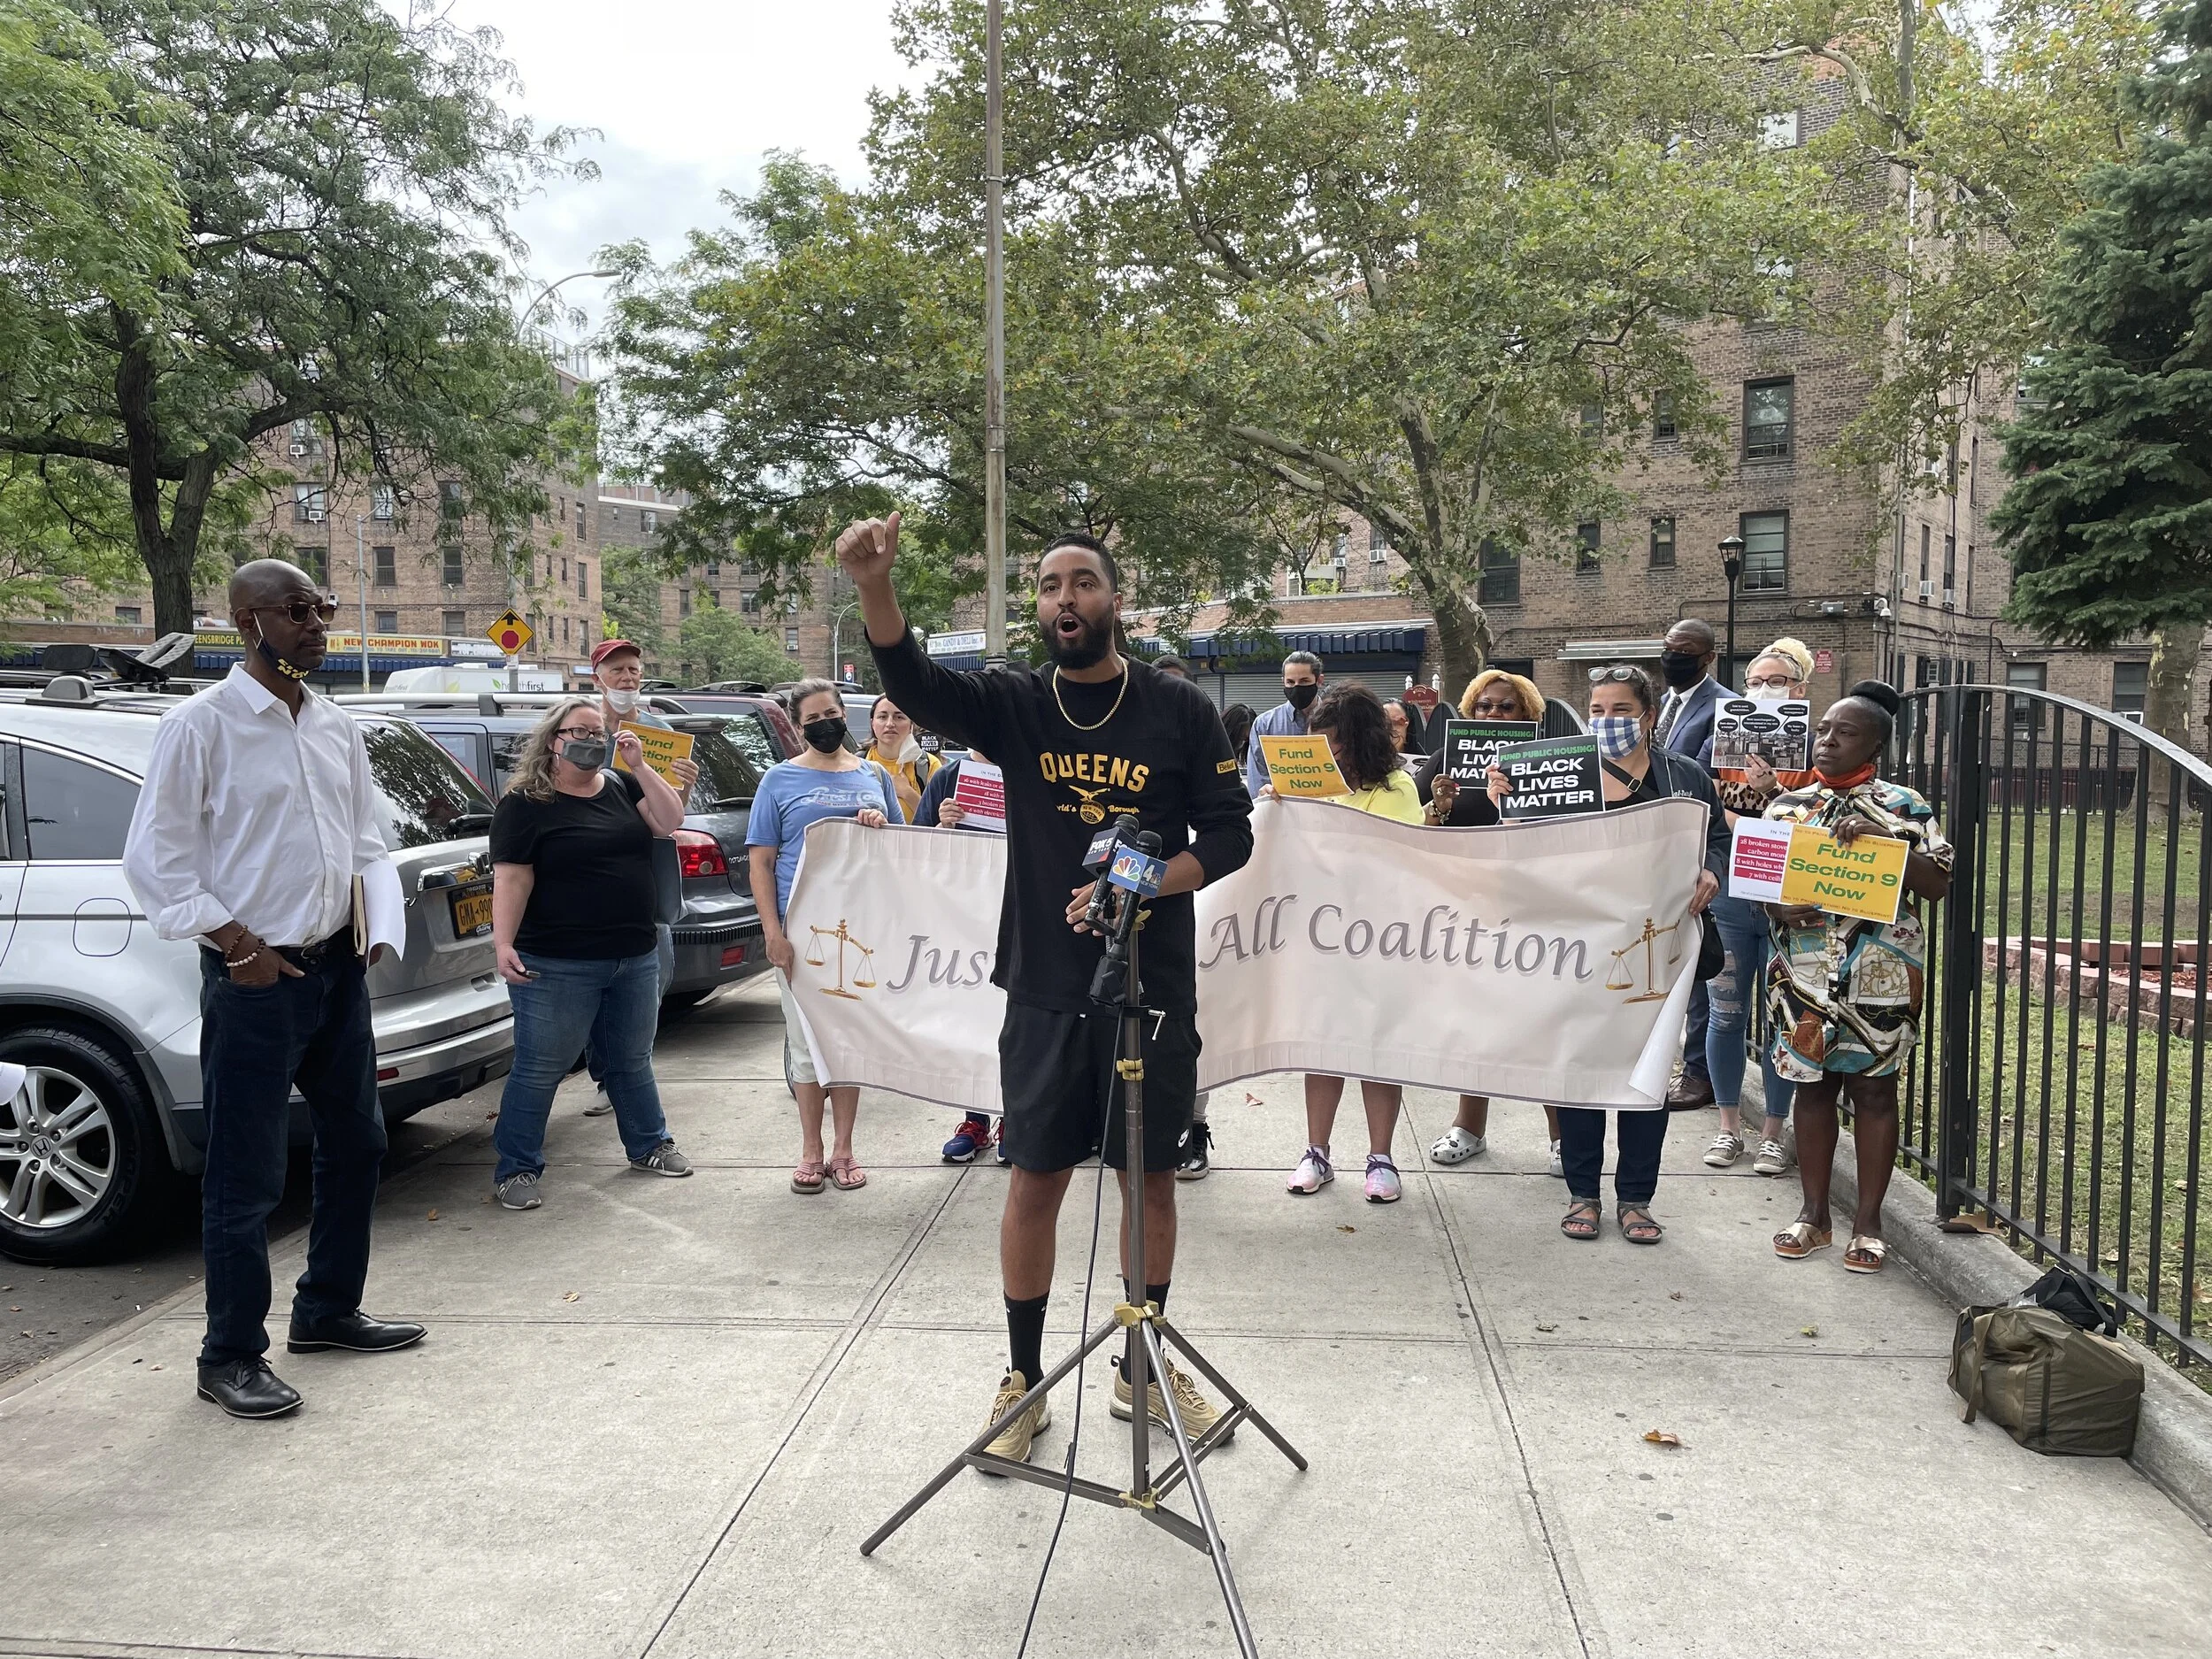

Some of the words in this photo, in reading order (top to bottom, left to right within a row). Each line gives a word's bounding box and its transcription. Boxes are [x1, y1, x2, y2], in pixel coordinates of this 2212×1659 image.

[195, 635, 234, 644] EENSBRIDGE
[368, 639, 418, 648] CHAMPION
[501, 680, 545, 691] hethfirst
[1497, 729, 1534, 738] HOUSING!
[1457, 739, 1521, 751] BLAC
[1279, 749, 1314, 759] Fund
[1500, 752, 1522, 762] FUND
[1522, 748, 1553, 758] PUBLIC
[1554, 744, 1596, 757] HOUSING!
[1463, 754, 1498, 765] LIVE
[1040, 751, 1150, 793] QUEENS
[1270, 763, 1321, 774] Section
[1323, 762, 1335, 772] 9
[1510, 757, 1585, 776] BLACK
[1449, 767, 1489, 780] MAT
[1289, 780, 1323, 788] Now
[1518, 775, 1579, 792] LIVES
[1506, 790, 1594, 809] MATTER
[1056, 803, 1078, 812] rld's
[1107, 804, 1141, 815] Borough
[1816, 842, 1877, 864] Fund
[1755, 860, 1772, 869] holes
[1142, 864, 1156, 881] 4
[1789, 857, 1875, 883] Section
[1880, 873, 1898, 887] 9
[1813, 880, 1866, 901] Now
[886, 933, 993, 994] Jus
[1197, 893, 1298, 972] All
[1307, 903, 1594, 981] Coalition
